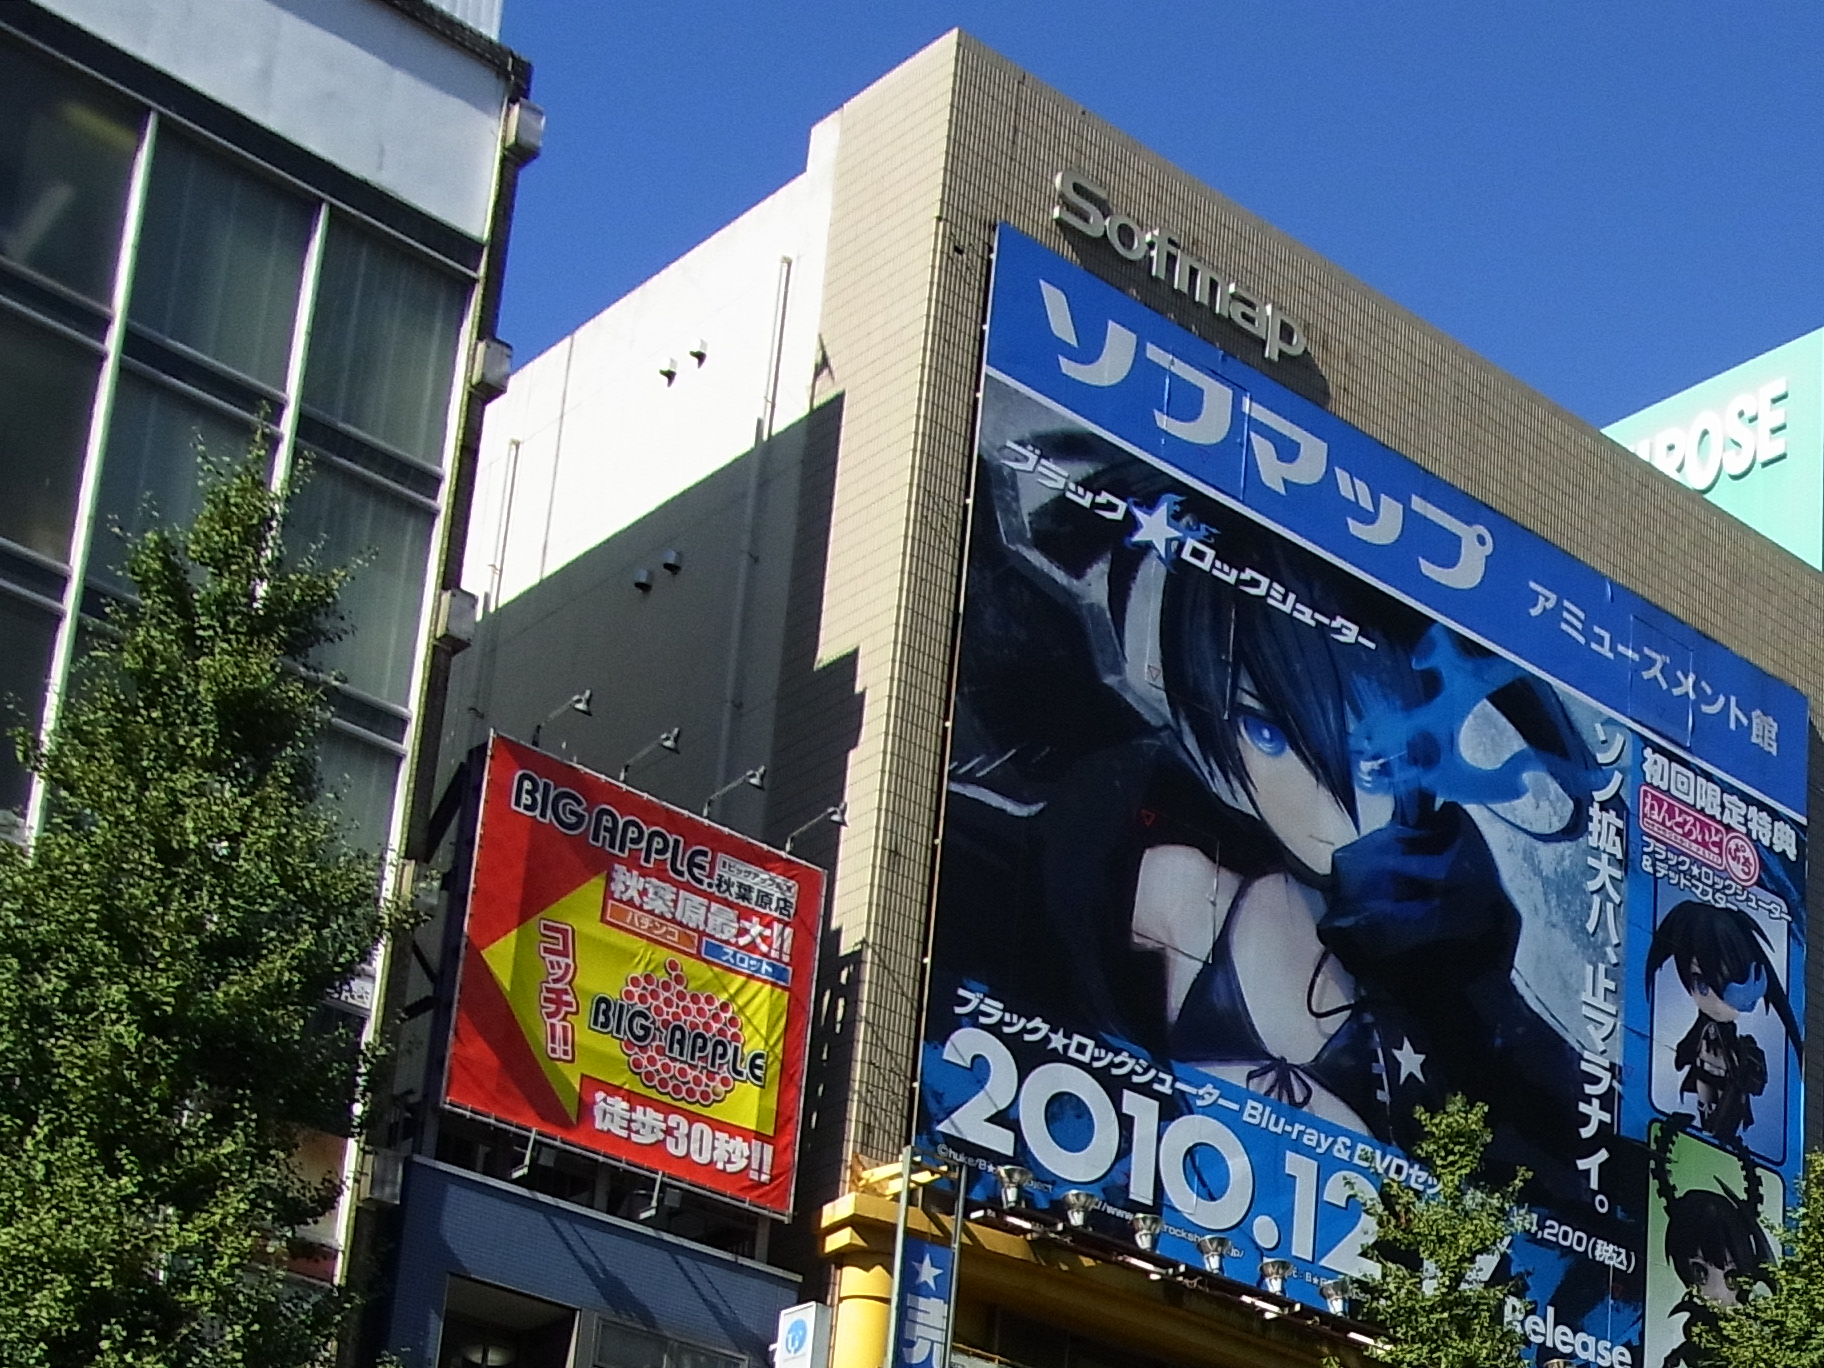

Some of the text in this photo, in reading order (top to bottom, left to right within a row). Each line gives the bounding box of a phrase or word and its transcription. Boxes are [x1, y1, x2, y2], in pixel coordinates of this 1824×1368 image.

[1053, 169, 1308, 364] Sofmap
[1039, 278, 1779, 756] ソフマップ アミューズメント館
[511, 770, 587, 835] BIG
[1641, 747, 1797, 862] 初回限定特典
[626, 910, 773, 975] パチンコ スロット
[715, 874, 794, 919] 秋葉原店
[590, 995, 767, 1087] BIG APPLE
[594, 1090, 774, 1183] 徒歩30秒!!
